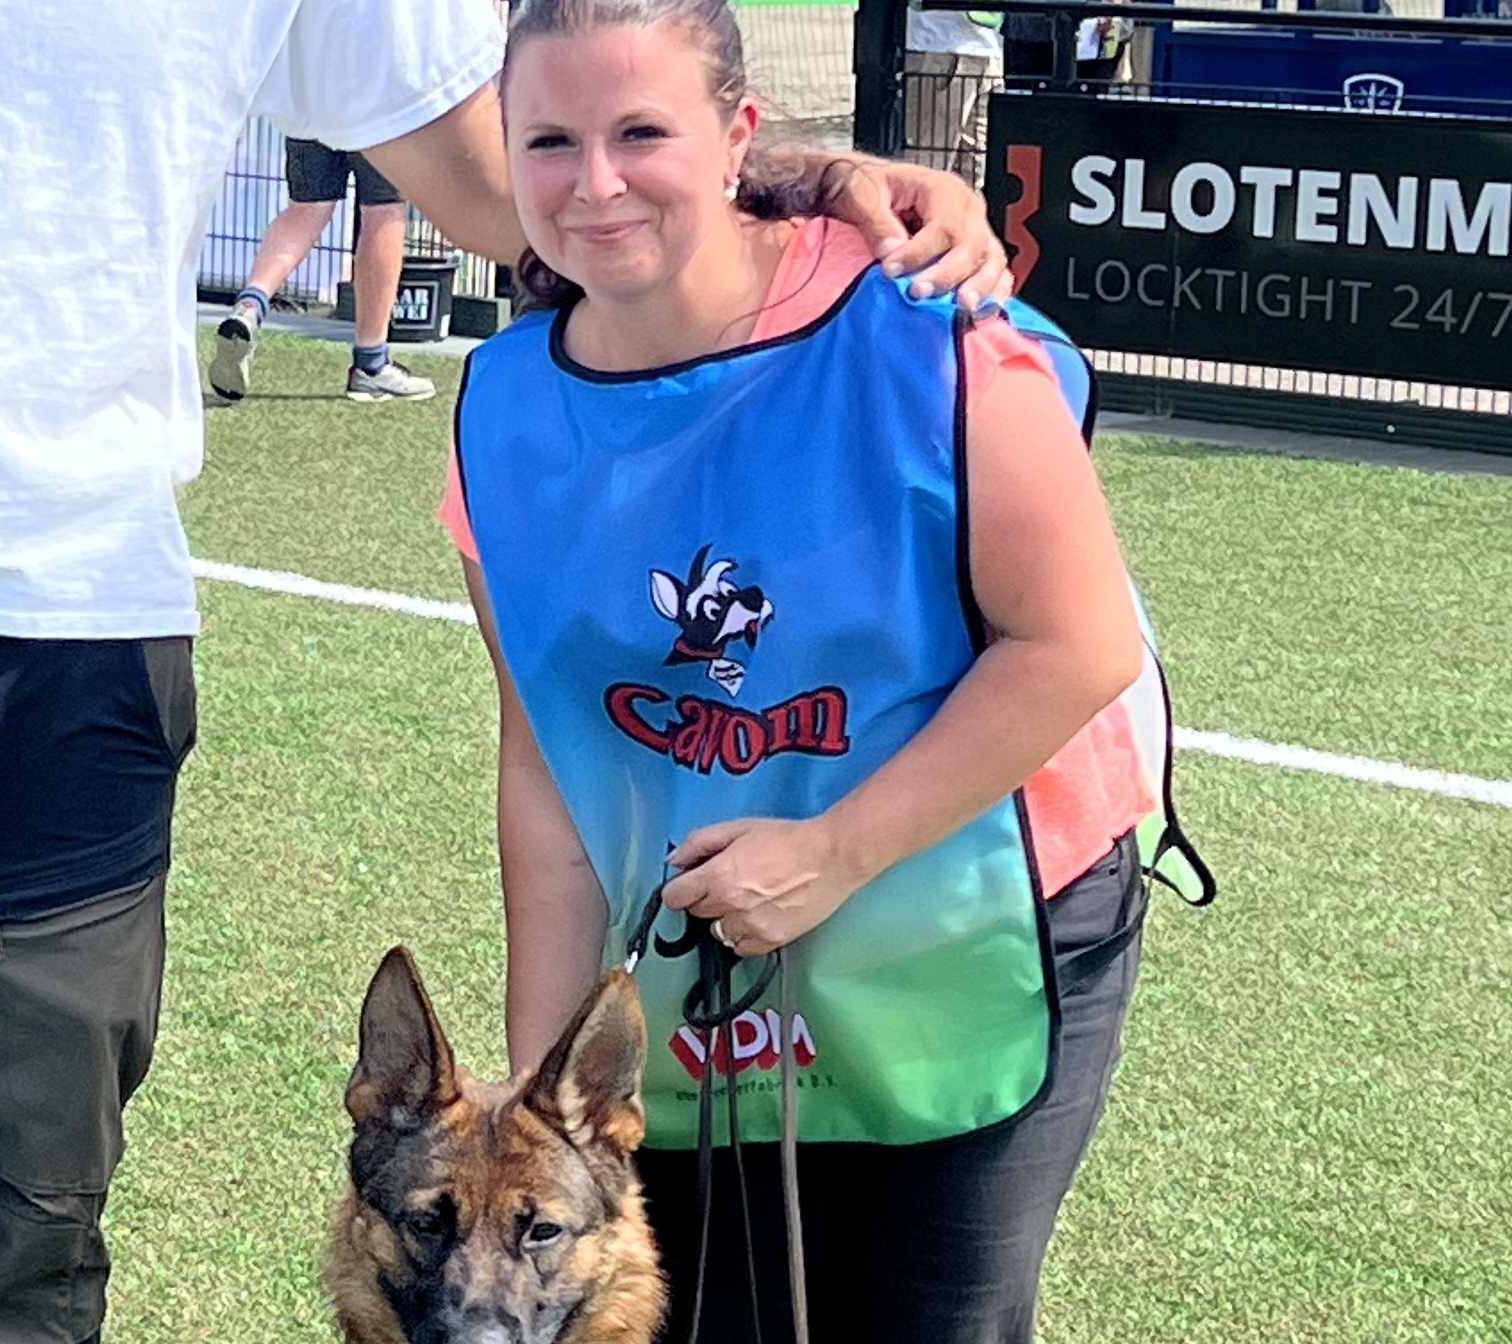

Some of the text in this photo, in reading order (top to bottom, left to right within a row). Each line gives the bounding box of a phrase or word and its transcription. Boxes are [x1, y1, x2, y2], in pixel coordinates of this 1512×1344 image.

[1068, 155, 1512, 256] SLOTENM
[1067, 256, 1512, 337] LOCKTIGHT 24/7
[603, 682, 851, 775] Carom
